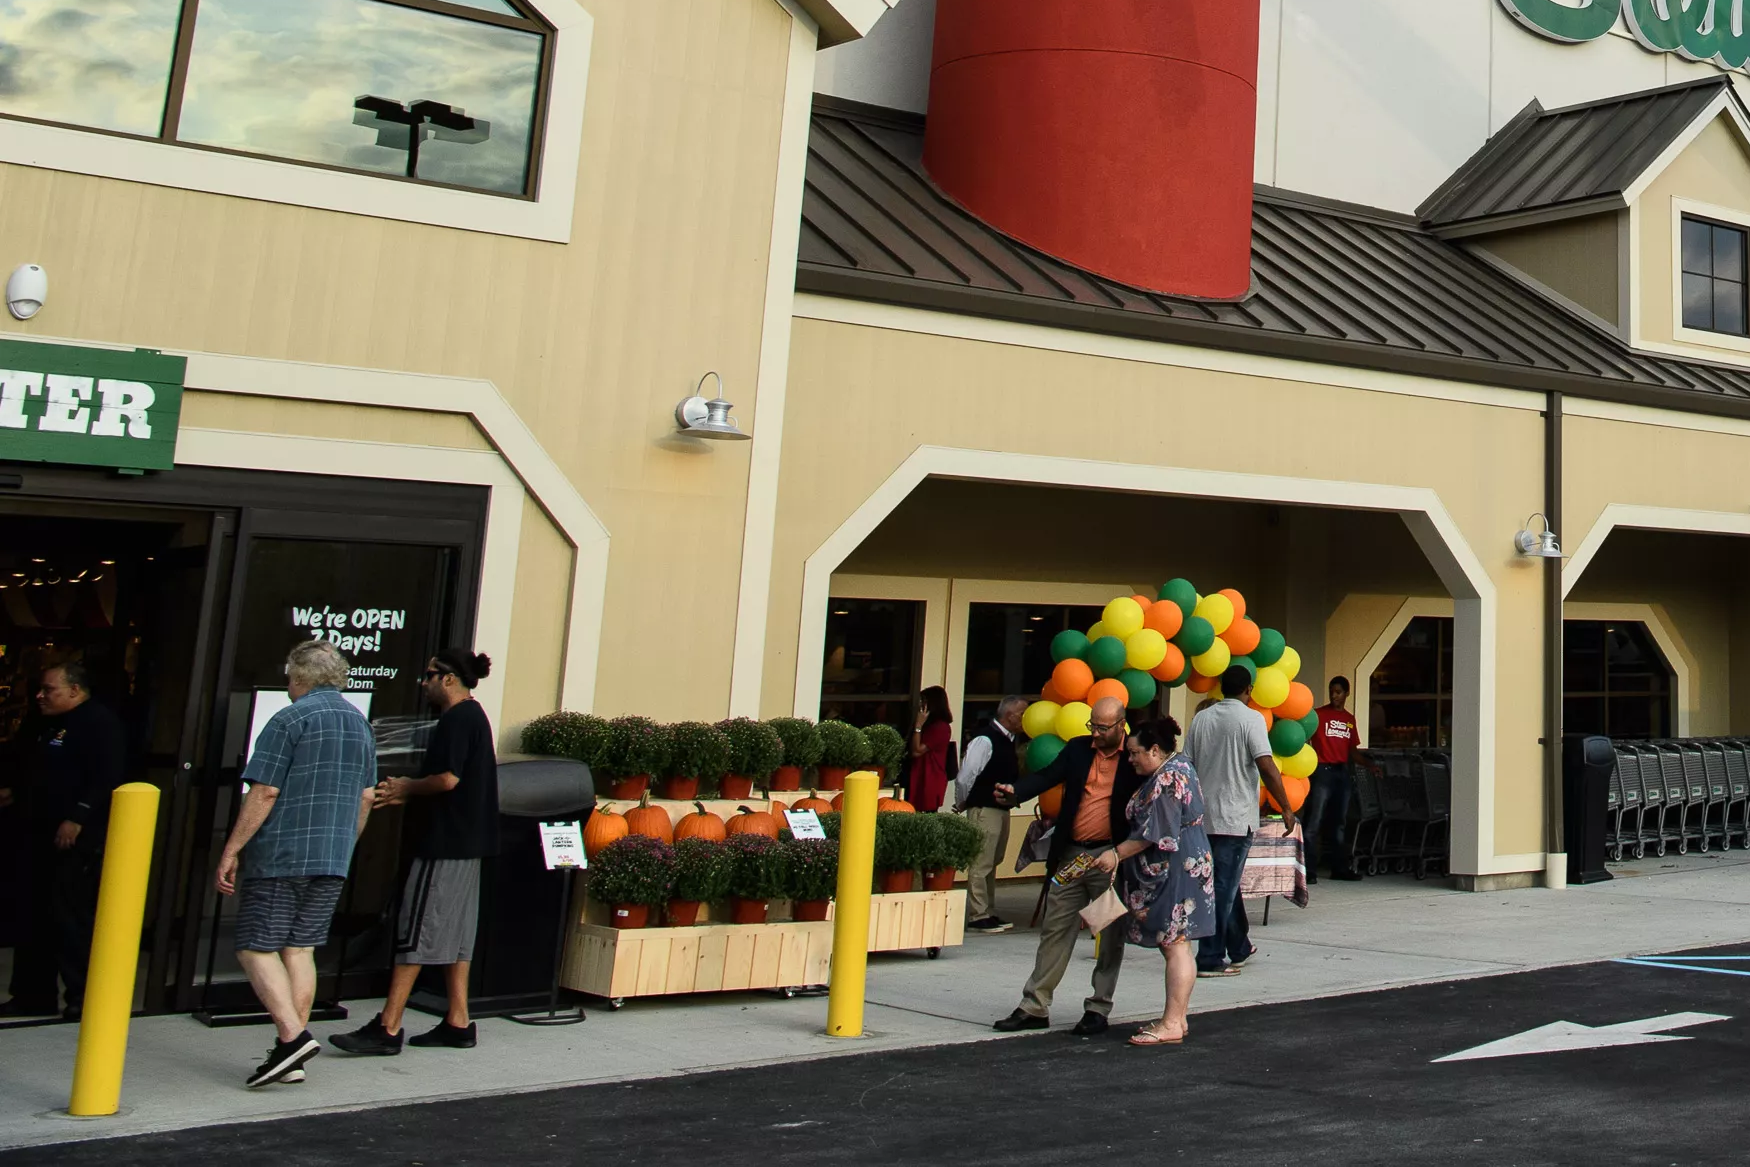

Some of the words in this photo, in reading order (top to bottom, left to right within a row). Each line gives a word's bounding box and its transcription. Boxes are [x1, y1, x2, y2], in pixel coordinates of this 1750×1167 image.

[0, 368, 156, 439] TER
[292, 605, 347, 628] We're
[351, 608, 406, 630] OPEN
[328, 629, 382, 656] Days!
[346, 677, 374, 689] 0pm
